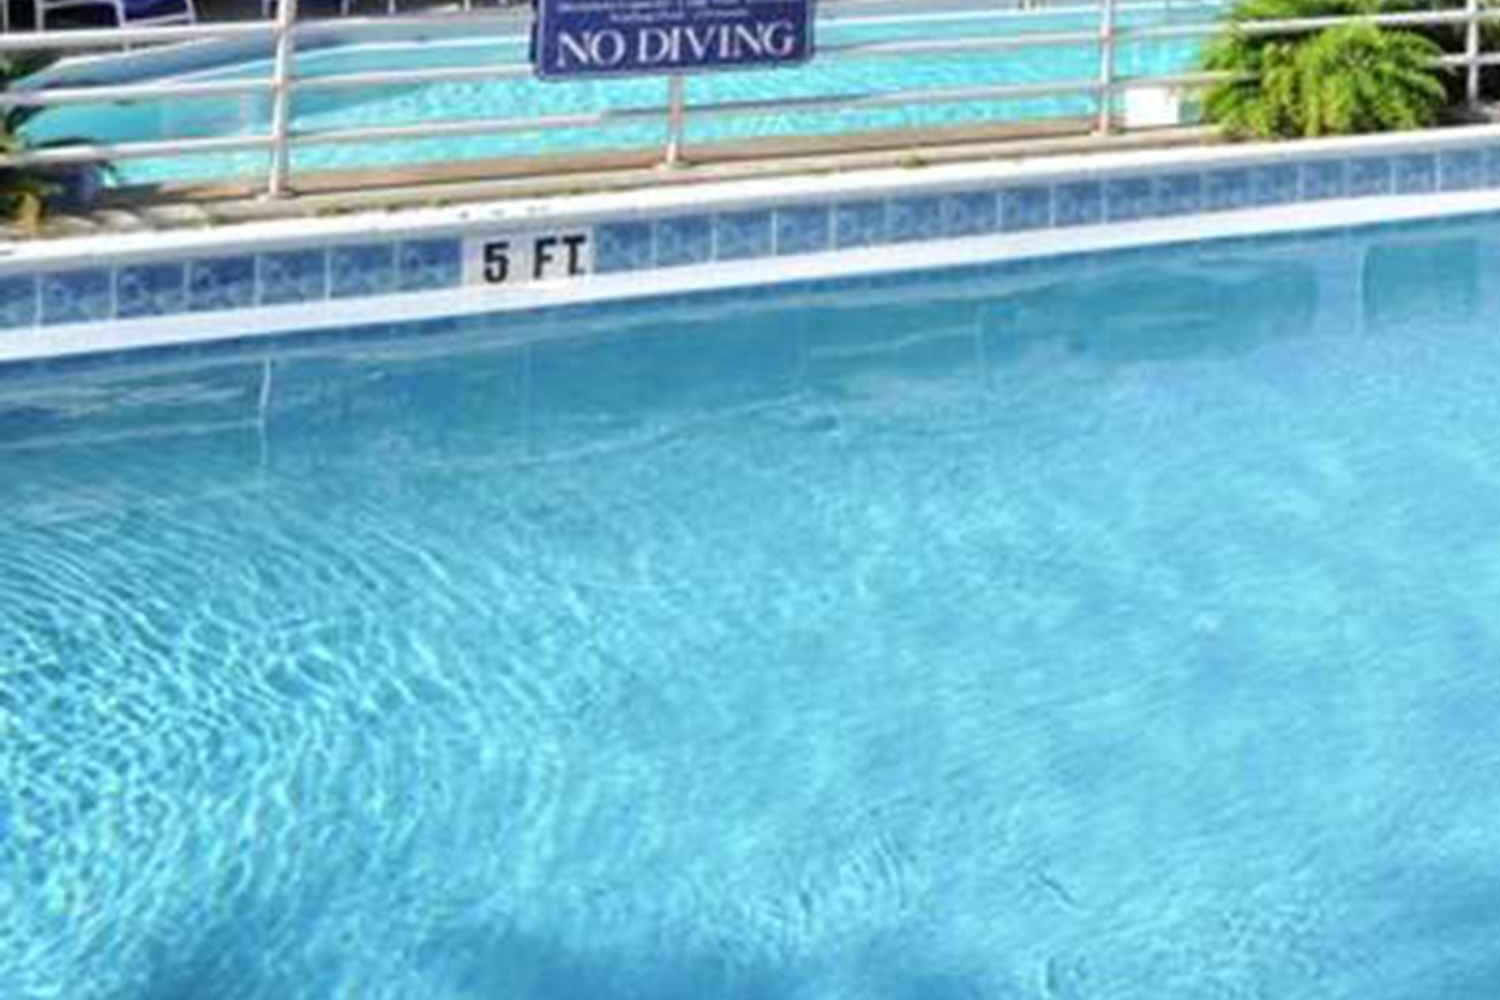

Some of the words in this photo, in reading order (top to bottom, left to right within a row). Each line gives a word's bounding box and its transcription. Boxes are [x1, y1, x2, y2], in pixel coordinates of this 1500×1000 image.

[556, 29, 626, 68] NO
[638, 21, 796, 63] DIVING
[482, 239, 511, 284] 5
